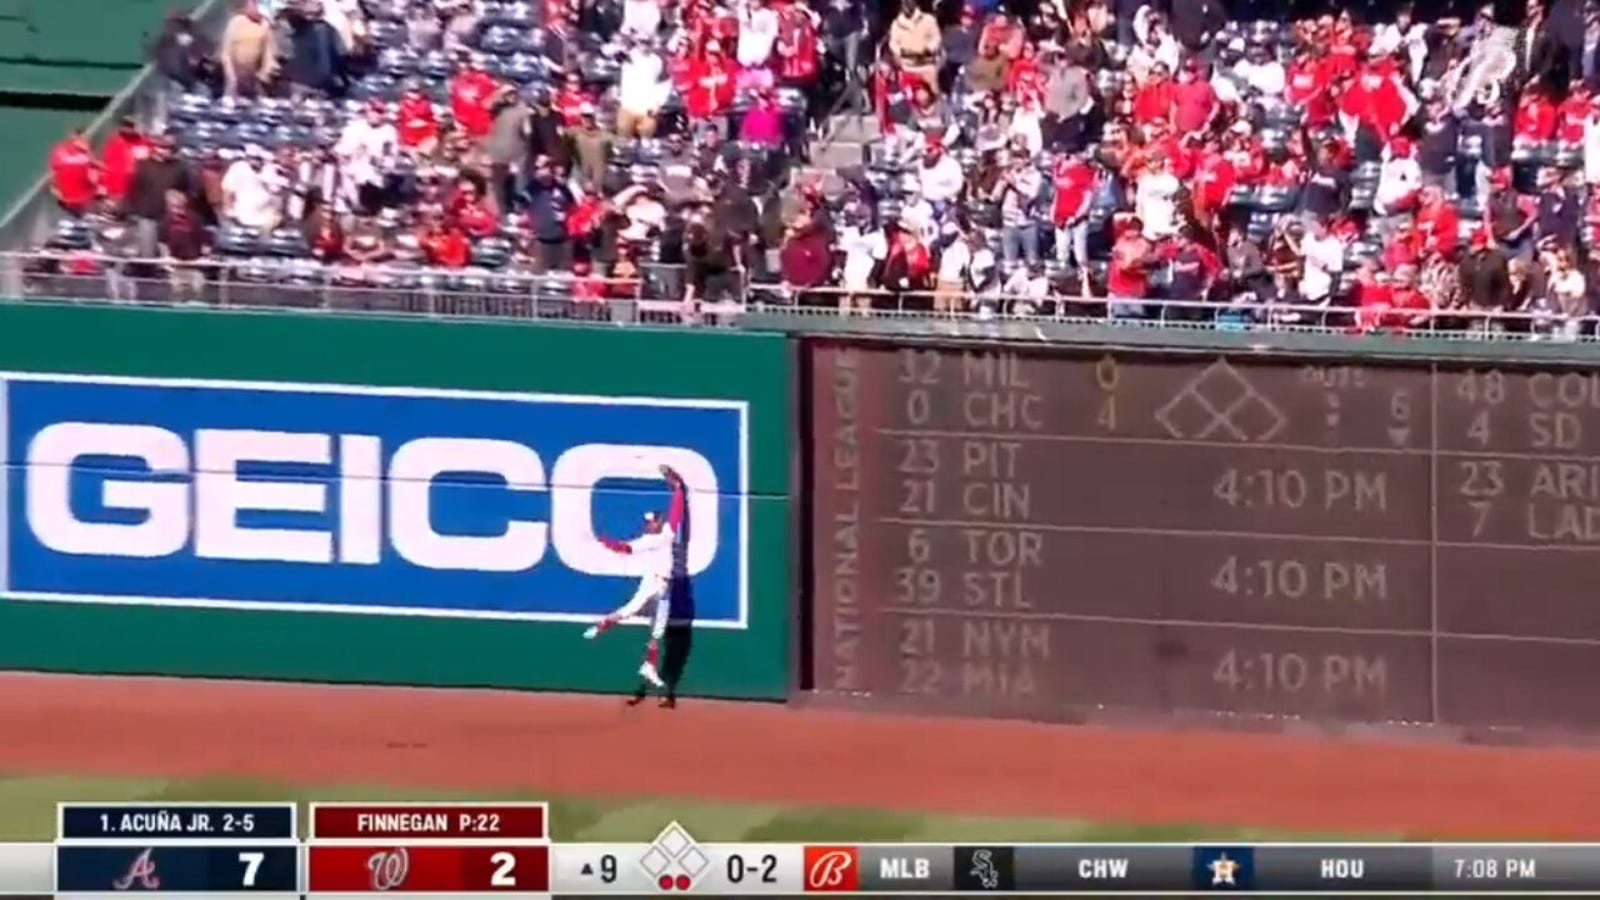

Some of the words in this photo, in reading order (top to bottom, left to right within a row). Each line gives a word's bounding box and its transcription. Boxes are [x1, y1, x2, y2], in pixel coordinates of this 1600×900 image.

[963, 352, 1030, 388] MIL
[834, 349, 859, 492] LEAGUE
[964, 391, 1043, 430] CHC
[1467, 411, 1489, 444] 4
[1530, 412, 1582, 448] SD
[900, 439, 940, 474] 23
[964, 441, 1022, 478] PIT
[1460, 460, 1504, 497] 23
[26, 421, 718, 577] GEICO
[900, 481, 936, 514] 21
[964, 482, 1030, 519] CIN
[1212, 469, 1307, 511] 4:10
[1324, 473, 1388, 513] PM
[1467, 501, 1492, 538] 7
[908, 529, 930, 563] 6
[962, 529, 1043, 567] TOR
[835, 500, 859, 690] NATIONAL
[896, 567, 941, 602] 39
[964, 571, 1034, 608] STL
[1210, 556, 1307, 598] 4:10
[1323, 562, 1388, 600] PM
[900, 618, 937, 655] 21
[964, 620, 1050, 659] NYM
[1211, 648, 1307, 692] 4:10
[1323, 654, 1388, 695] PM
